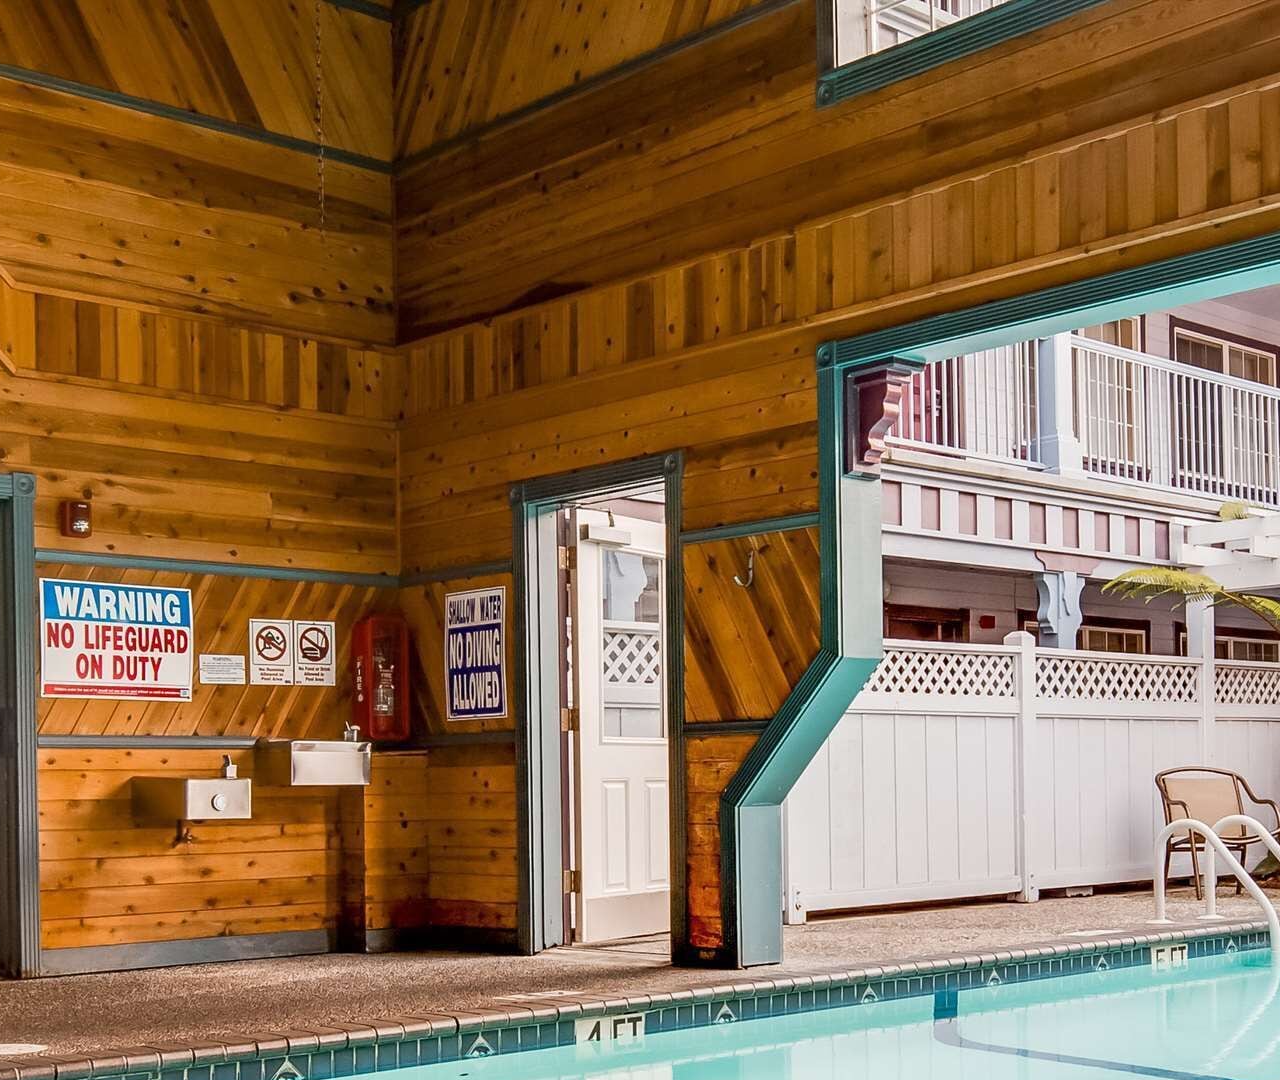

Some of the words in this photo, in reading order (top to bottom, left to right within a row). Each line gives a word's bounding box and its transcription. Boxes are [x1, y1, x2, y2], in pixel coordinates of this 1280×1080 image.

[54, 585, 181, 624] WARNING
[448, 598, 475, 625] SHALLOW
[480, 595, 501, 621] WATER
[47, 622, 75, 649] NO
[84, 624, 188, 654] LIFEGUARD
[449, 633, 464, 669] NO
[466, 628, 500, 668] DIVING
[76, 653, 103, 680] ON
[113, 655, 162, 681] DUTY
[453, 671, 500, 710] ALLOWED
[1170, 946, 1186, 961] FT
[613, 1015, 643, 1039] FT
